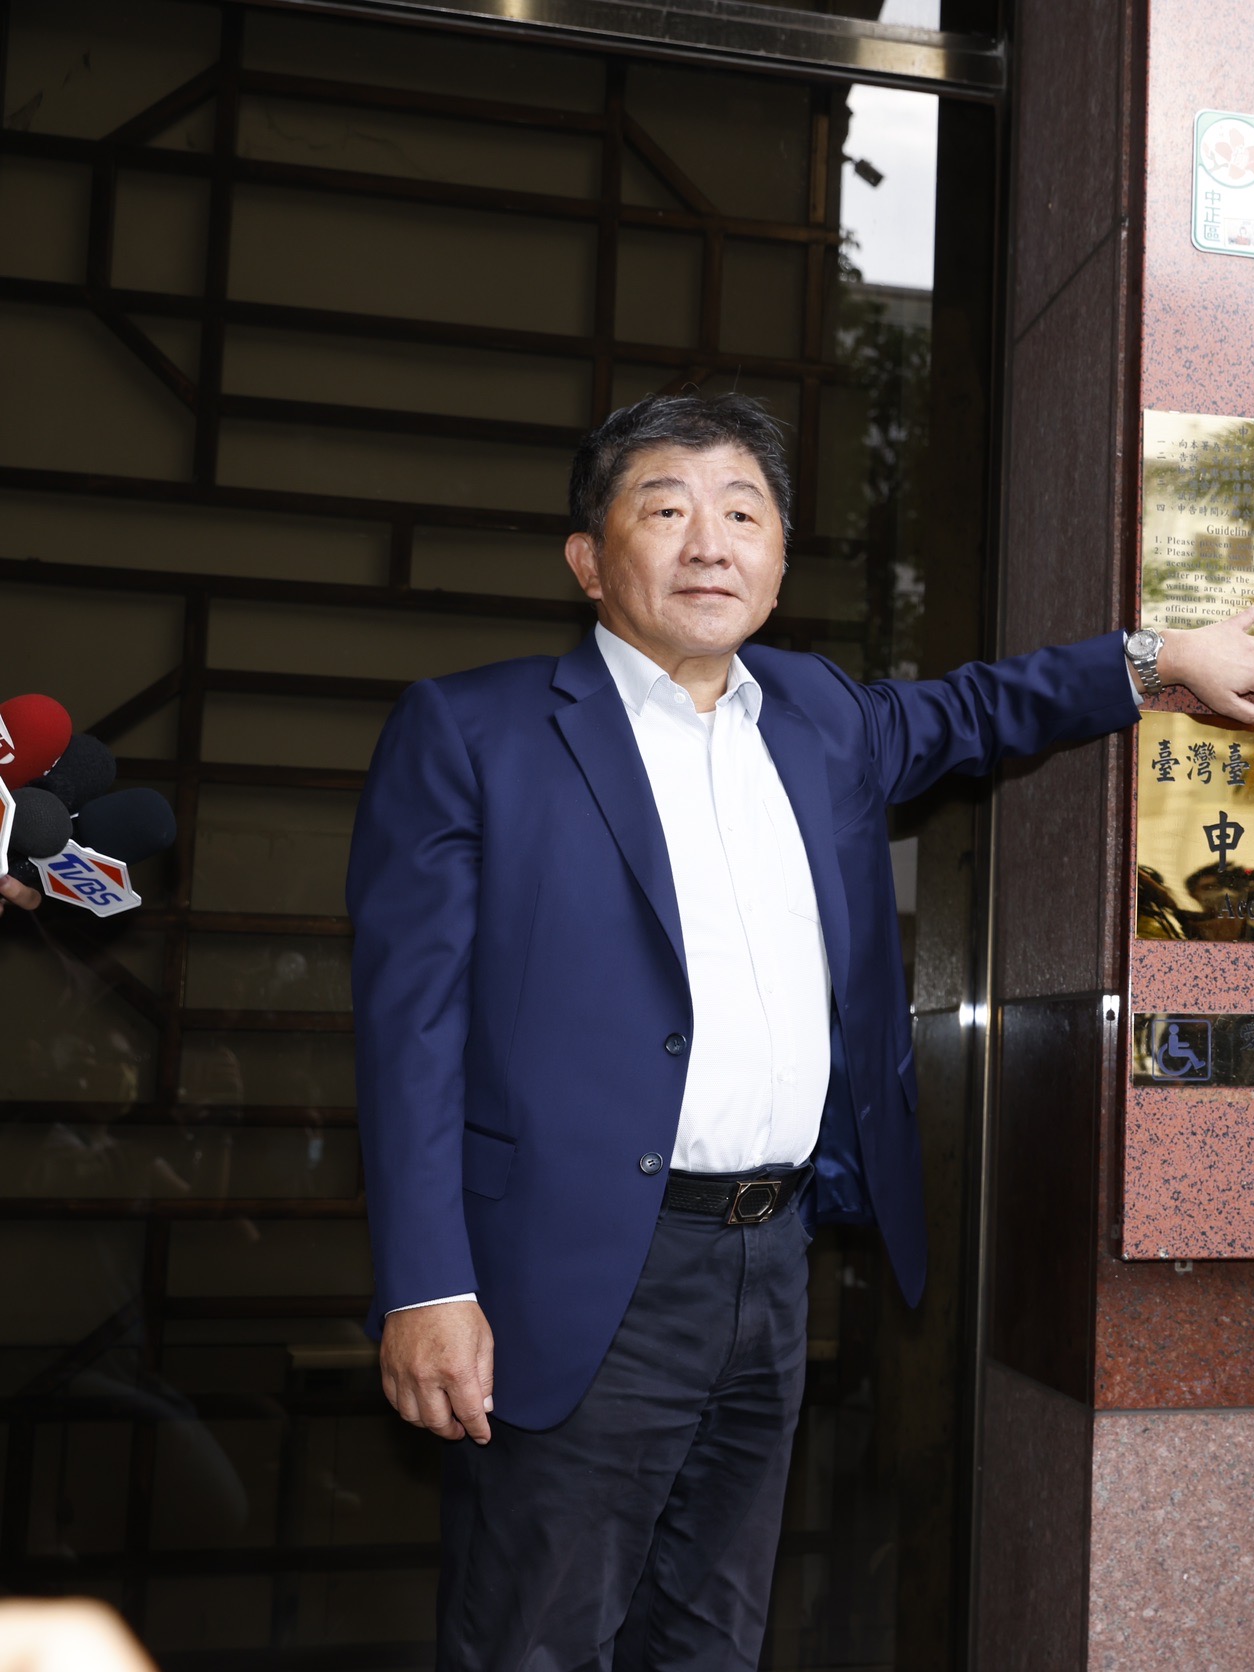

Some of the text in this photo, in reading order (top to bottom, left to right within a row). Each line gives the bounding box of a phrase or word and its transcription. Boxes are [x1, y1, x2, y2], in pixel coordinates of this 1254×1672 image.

[1203, 189, 1221, 242] 中正區
[1154, 535, 1162, 544] 1.
[1167, 536, 1195, 546] Please
[1154, 547, 1162, 555] 2.
[1167, 548, 1196, 557] Please
[1194, 573, 1232, 584] pressing
[1236, 575, 1249, 583] the
[1166, 582, 1200, 593] waiting
[1203, 586, 1226, 594] area.
[1230, 586, 1237, 594] A
[1165, 594, 1201, 603] conduct
[1205, 596, 1216, 604] an
[1221, 596, 1253, 607] inquiry
[1165, 604, 1198, 614] official
[1202, 607, 1231, 617] record
[1165, 615, 1192, 627] Filing
[48, 853, 123, 906] TVBS
